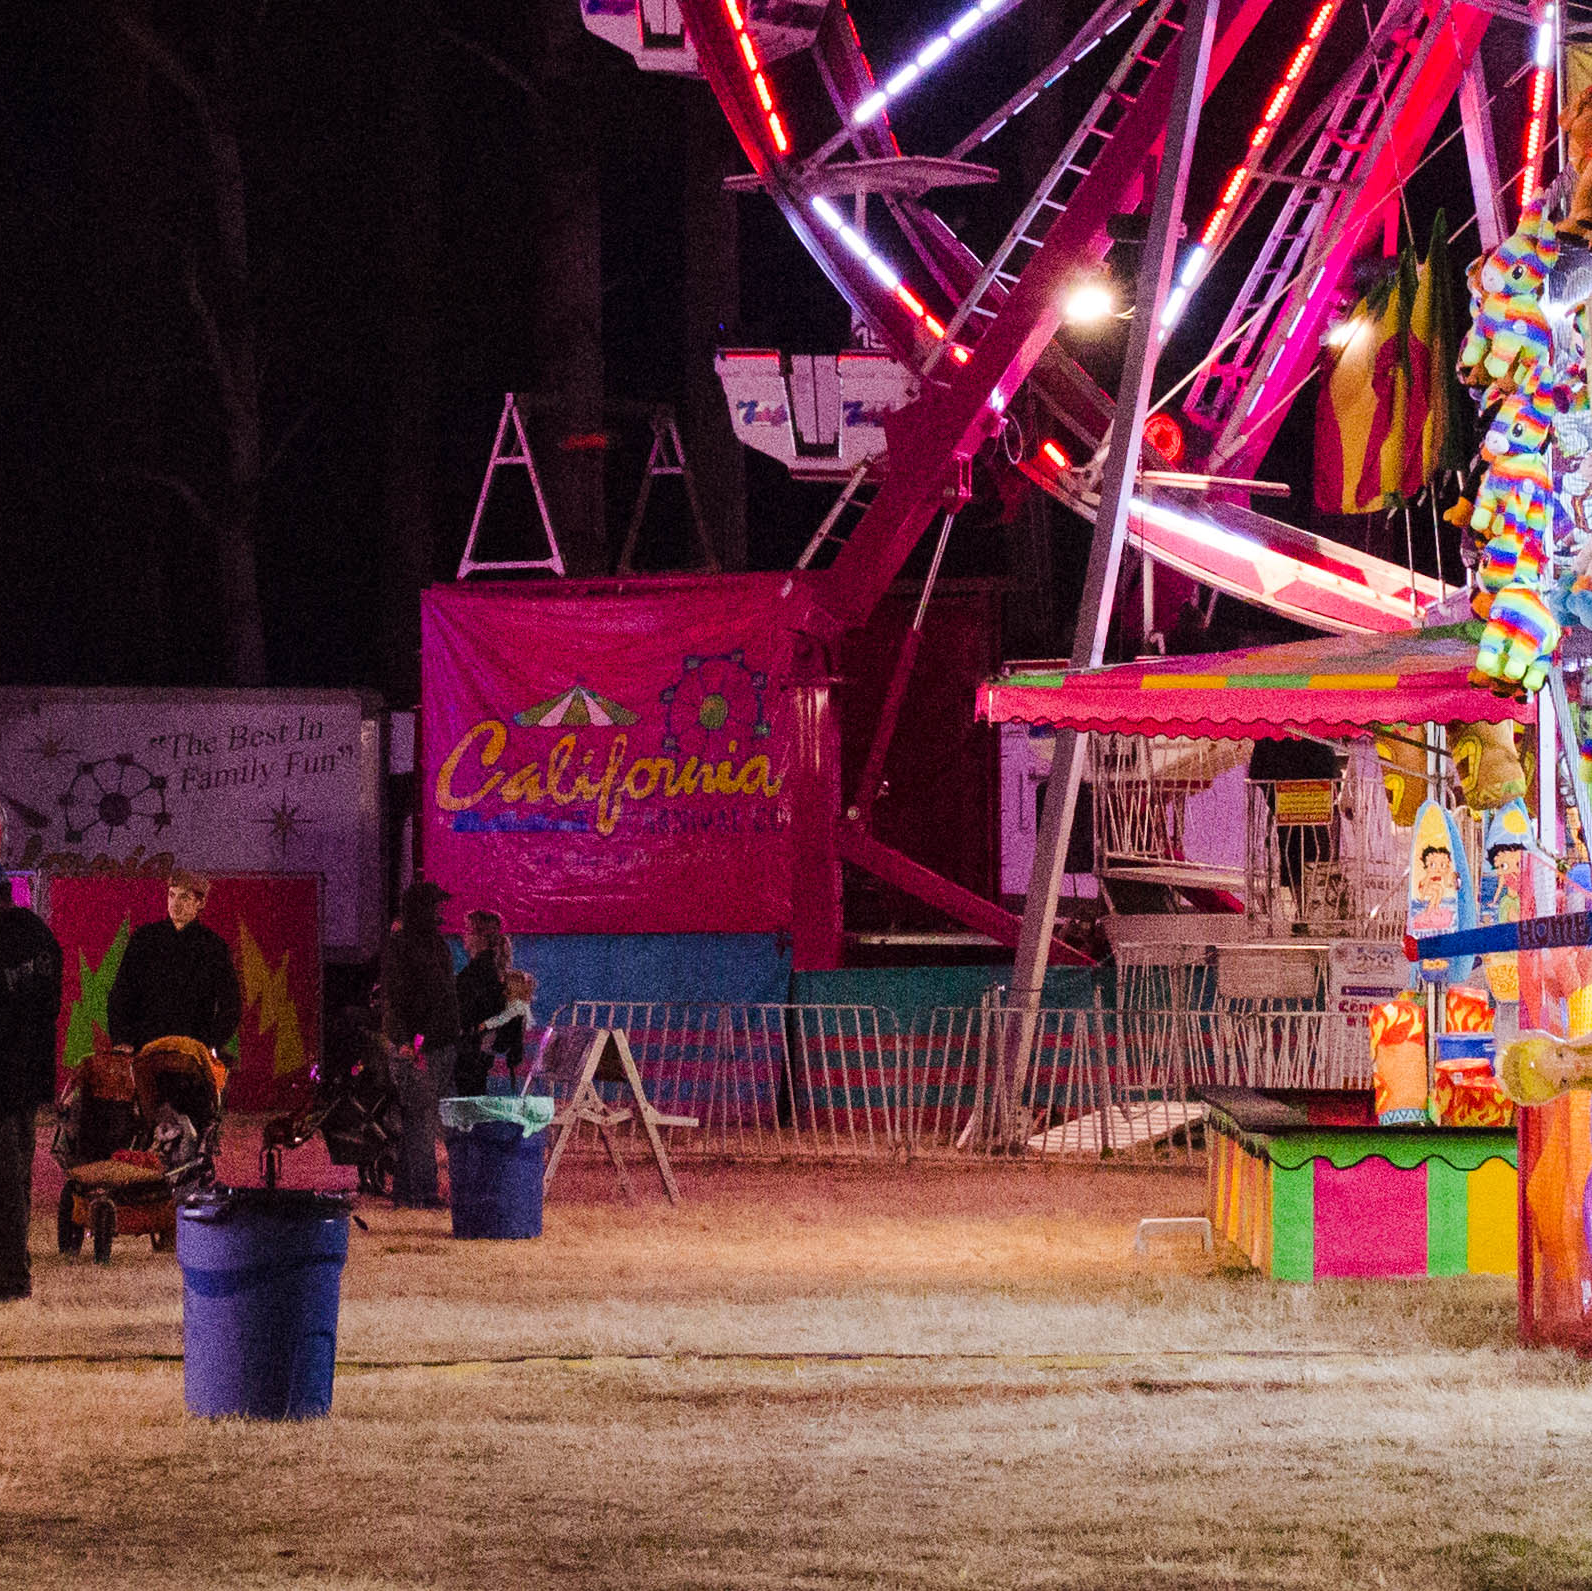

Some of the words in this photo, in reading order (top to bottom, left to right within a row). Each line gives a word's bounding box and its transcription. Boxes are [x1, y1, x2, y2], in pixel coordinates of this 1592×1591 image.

[227, 723, 289, 753] Best
[297, 716, 326, 743] In
[179, 756, 274, 794] Family
[434, 719, 784, 836] California
[1518, 916, 1591, 948] HOME
